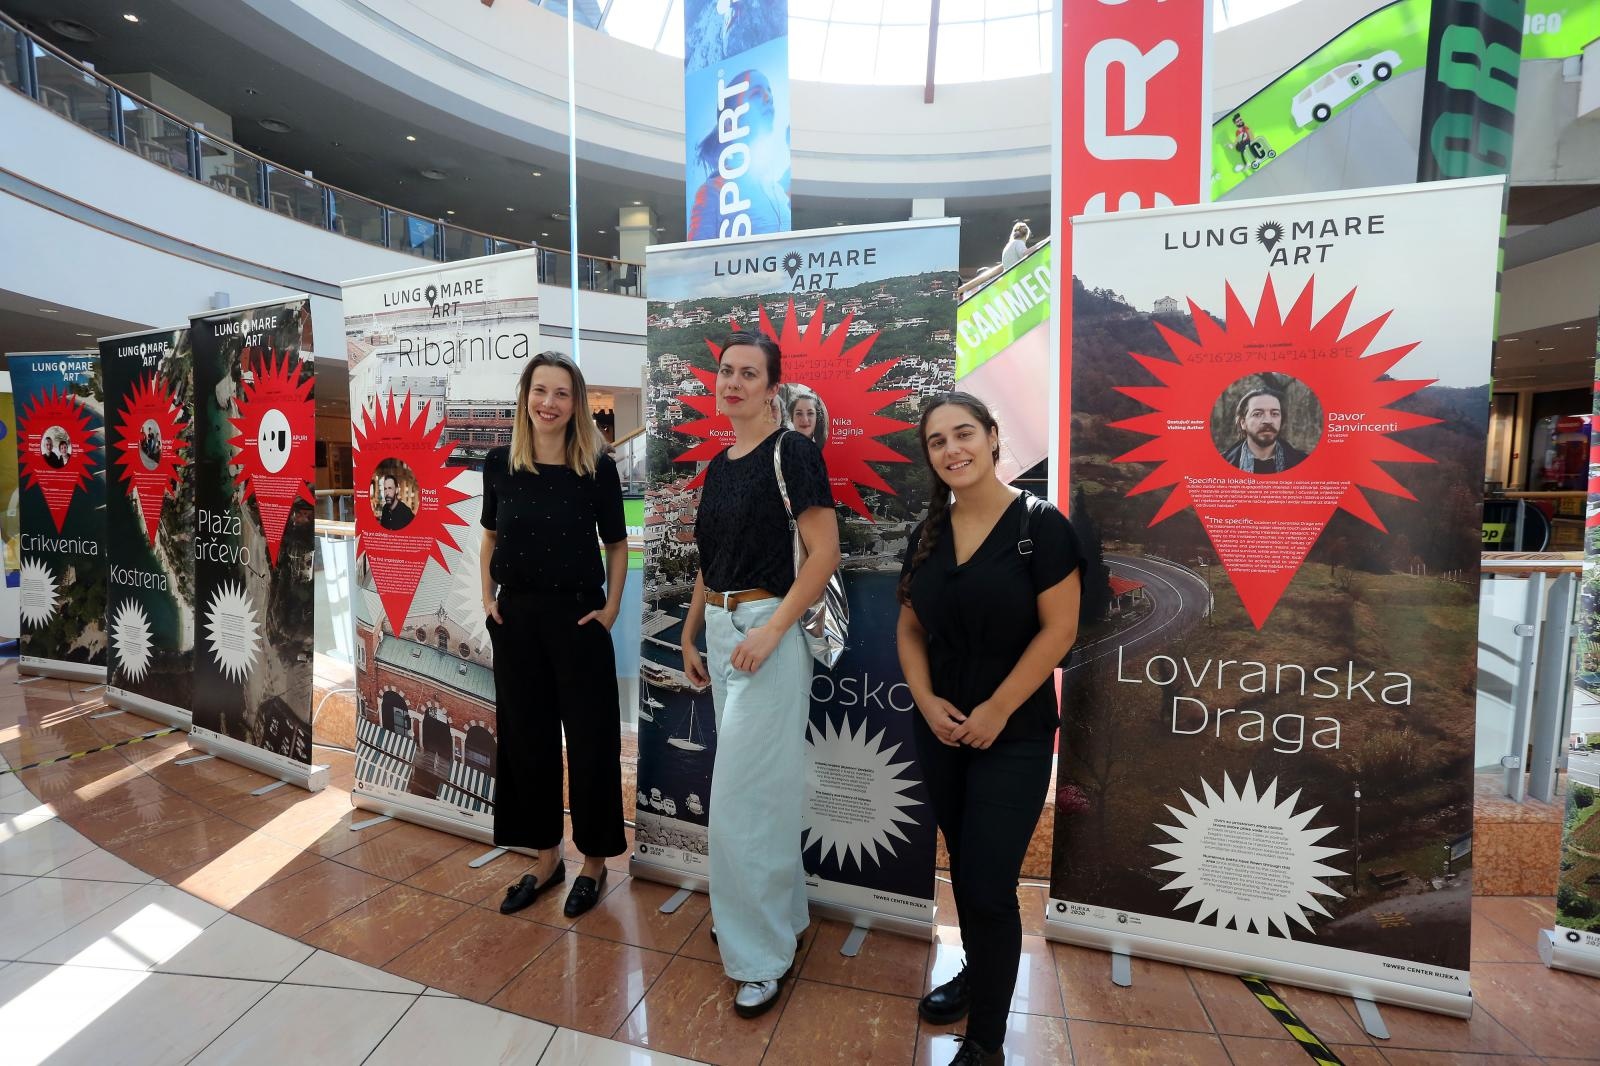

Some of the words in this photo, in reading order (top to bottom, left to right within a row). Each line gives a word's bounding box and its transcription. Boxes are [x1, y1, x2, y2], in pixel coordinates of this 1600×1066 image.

[717, 77, 751, 241] SPORT
[1269, 243, 1334, 267] ART
[792, 272, 839, 292] ART
[432, 301, 461, 318] ART
[246, 334, 263, 348] ART
[399, 329, 529, 368] Ribarnica
[142, 356, 157, 367] ART
[64, 372, 80, 382] ART
[832, 418, 852, 426] Nika
[1328, 412, 1366, 421] Davor
[832, 428, 864, 437] Laginja
[1328, 422, 1398, 432] Sanvincenti
[1227, 478, 1256, 486] lokacija
[198, 509, 242, 536] Plaža
[20, 533, 98, 556] Crikvenica
[194, 536, 250, 566] Grčevo
[110, 564, 168, 592] Kostrena
[1118, 646, 1412, 706] Lovranska
[810, 672, 914, 713] osko
[1172, 696, 1340, 754] Draga
[1407, 967, 1434, 976] CENTER
[1434, 972, 1460, 981] RIJEKA
